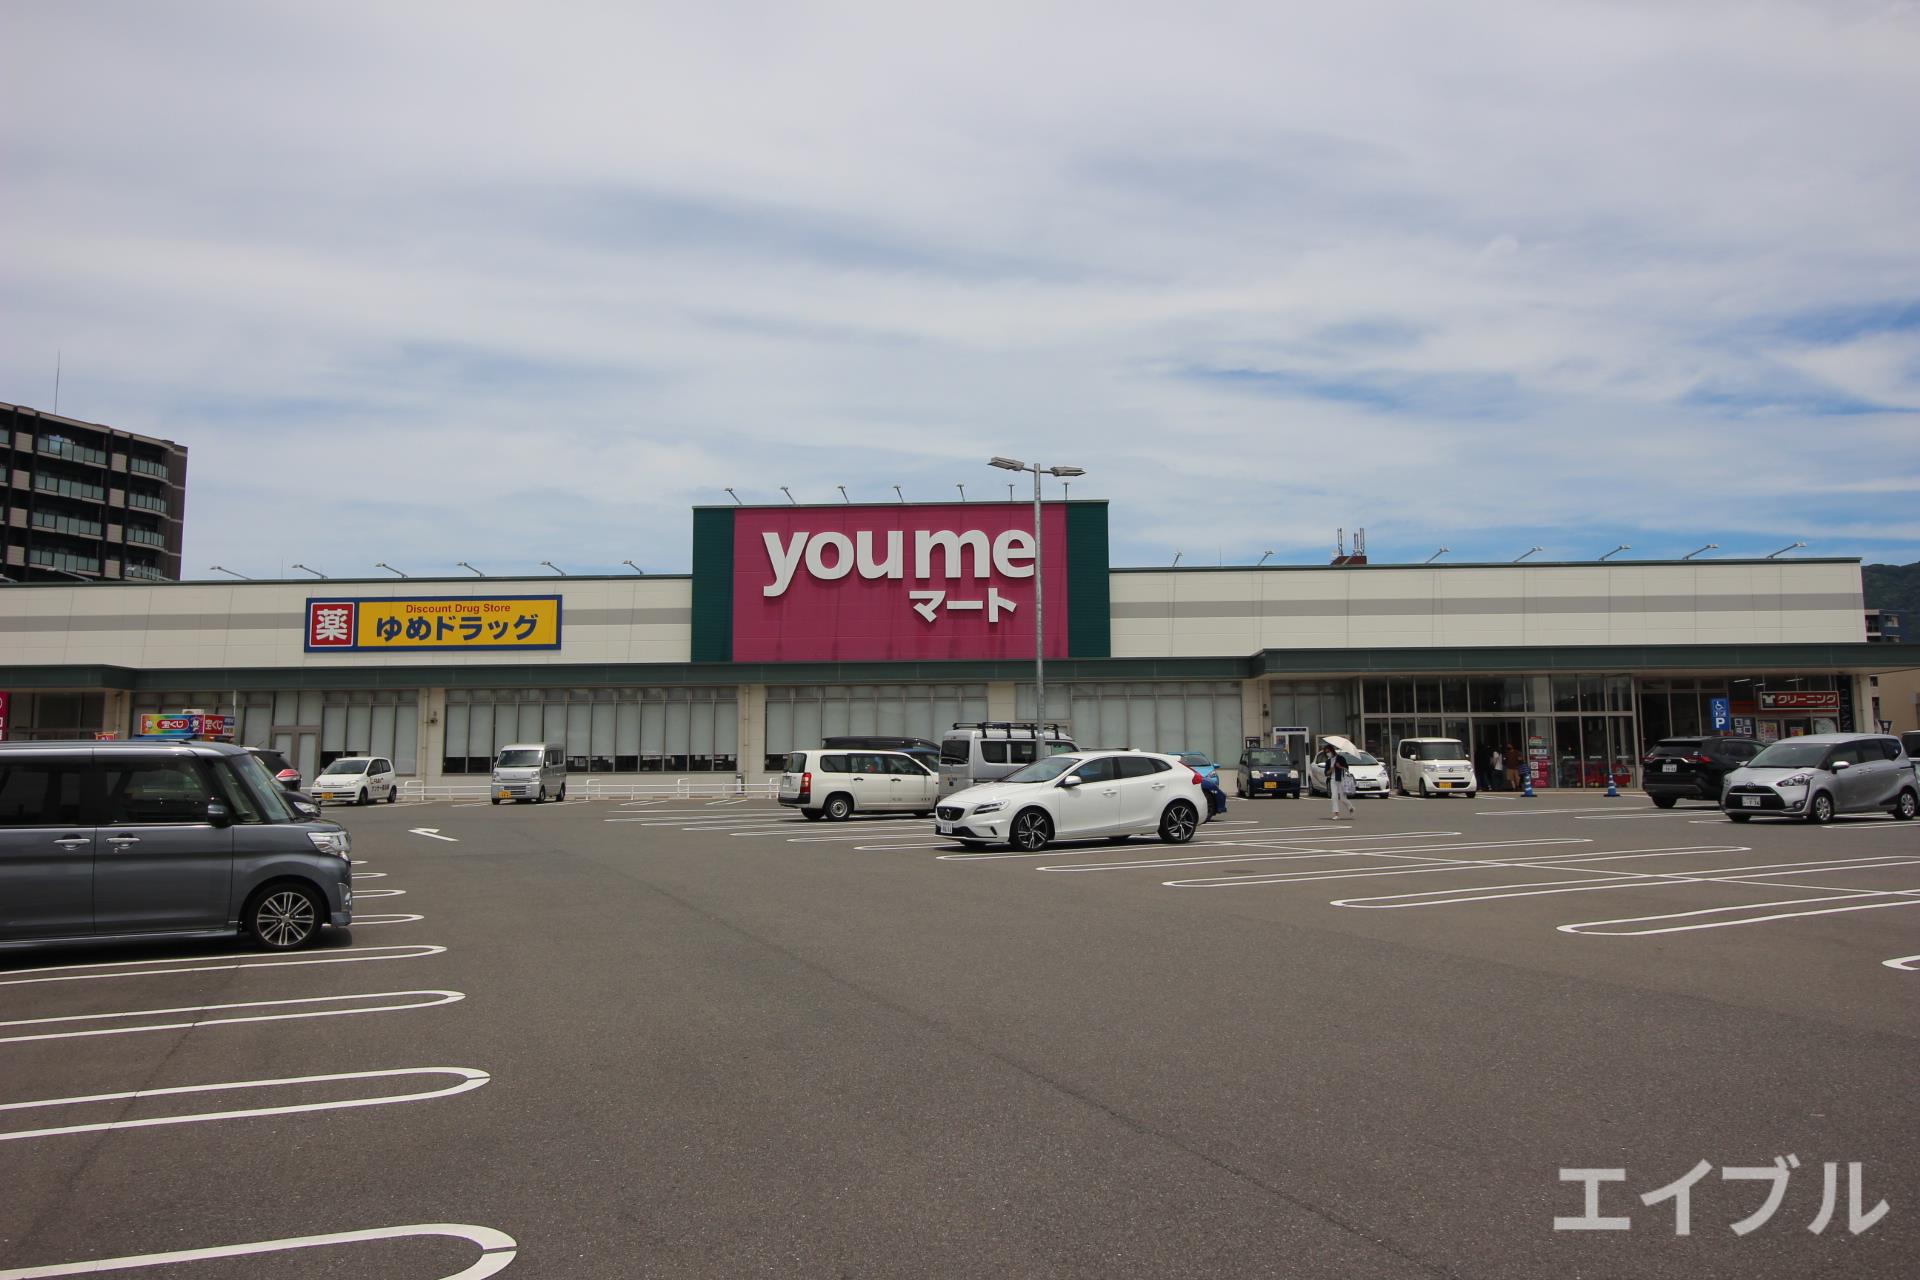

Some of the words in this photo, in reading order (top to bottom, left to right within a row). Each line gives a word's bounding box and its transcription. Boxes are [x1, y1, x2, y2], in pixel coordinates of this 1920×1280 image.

[405, 604, 452, 614] Discount
[455, 604, 480, 615] Drug
[483, 603, 511, 613] Store
[909, 587, 1018, 623] マート
[316, 608, 348, 641] 薬
[376, 614, 539, 642] ゆめドラッグ
[1777, 694, 1837, 704] クリーニング
[1715, 717, 1726, 729] P
